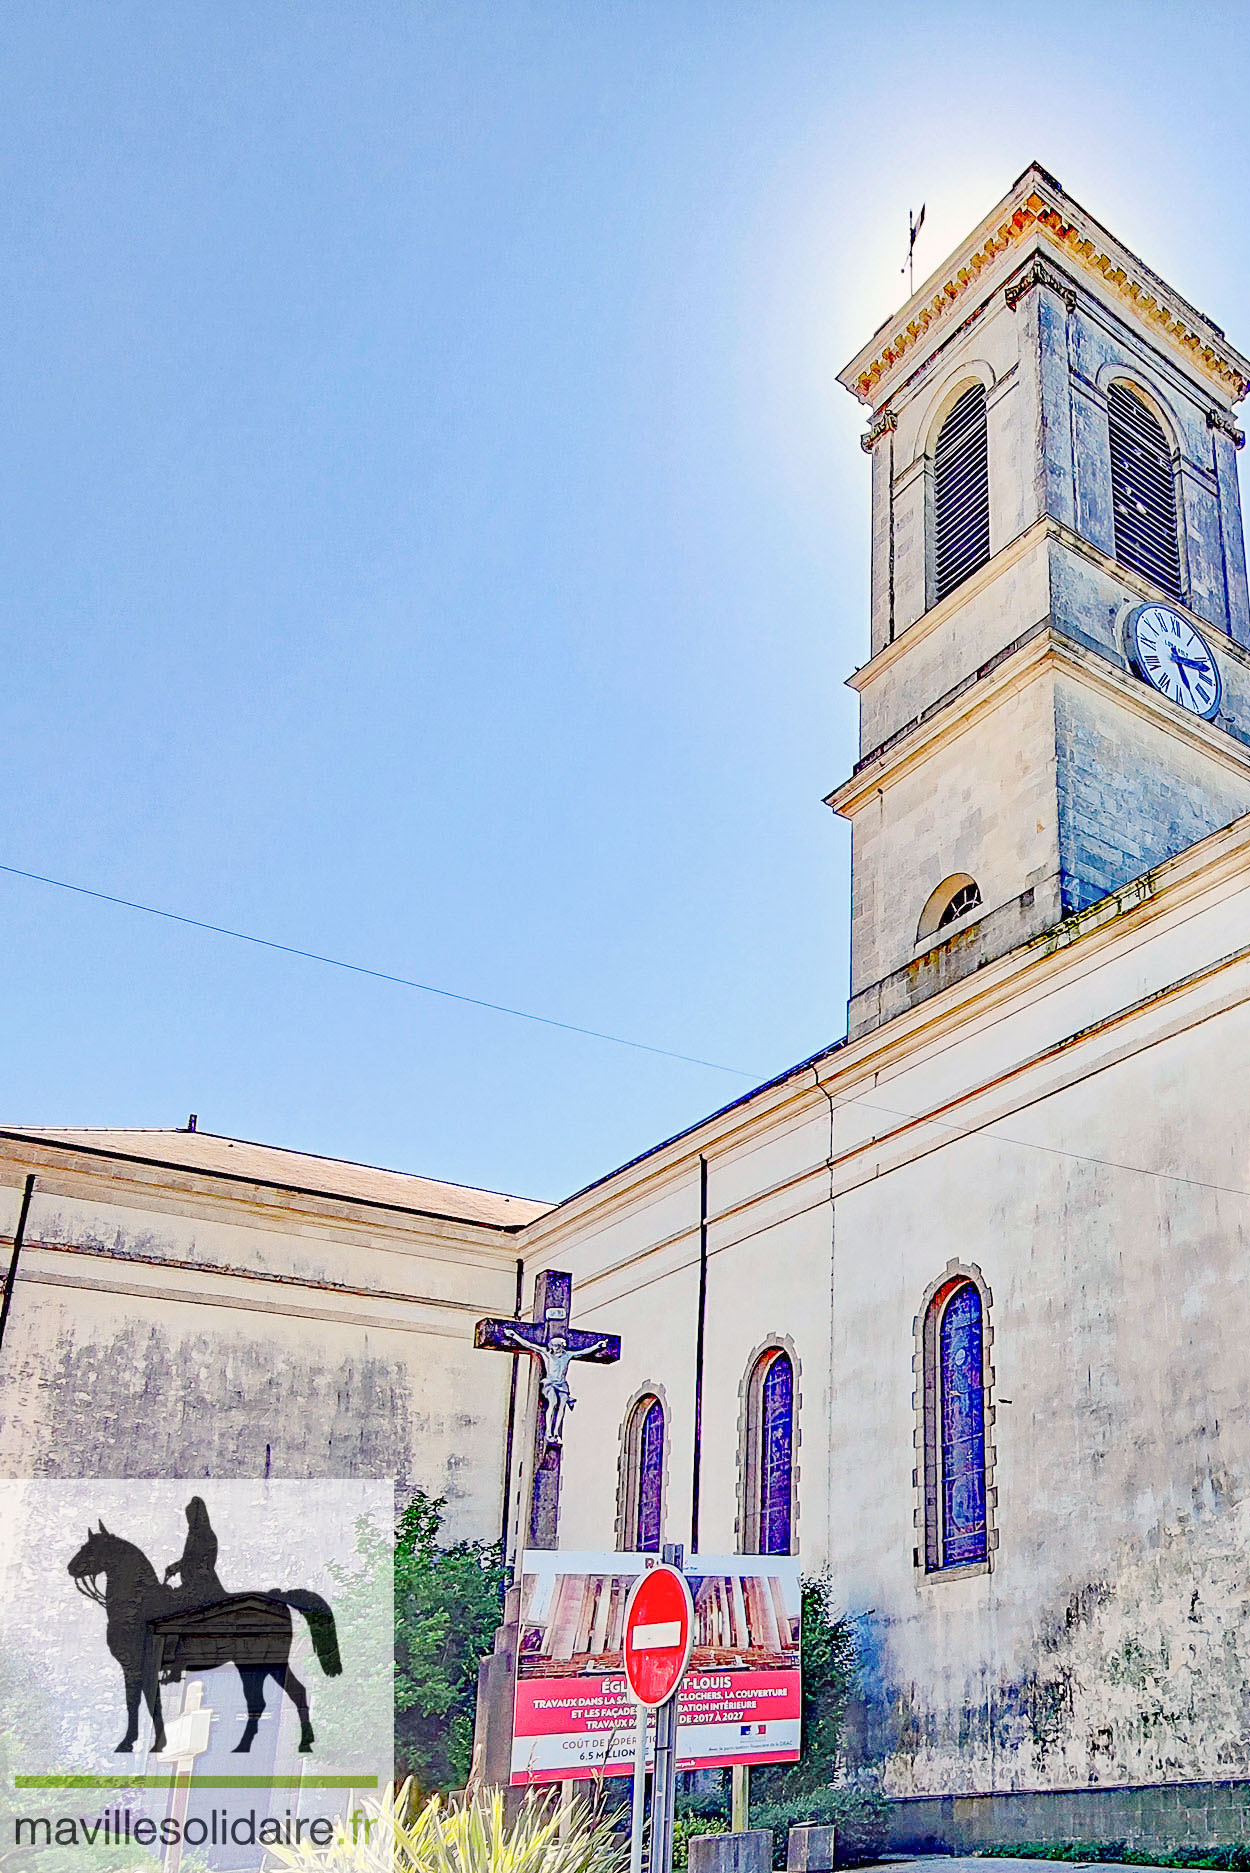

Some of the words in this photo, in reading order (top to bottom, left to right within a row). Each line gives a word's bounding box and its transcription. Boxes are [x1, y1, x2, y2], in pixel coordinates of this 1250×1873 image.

[533, 1698, 578, 1709] TRAVAUX
[579, 1696, 603, 1706] DANS
[604, 1696, 618, 1705] LA
[725, 1691, 735, 1699] LA
[736, 1688, 787, 1698] COUVERTURE
[571, 1709, 583, 1719] ET
[584, 1708, 600, 1718] LES
[710, 1700, 757, 1711] INTÉRIEURE
[586, 1718, 628, 1729] TRAVAUX
[679, 1714, 692, 1723] DE
[693, 1712, 713, 1722] 2017
[715, 1711, 721, 1721] À
[720, 1712, 744, 1721] 2027
[562, 1738, 590, 1750] COÛT
[593, 1739, 605, 1748] DE
